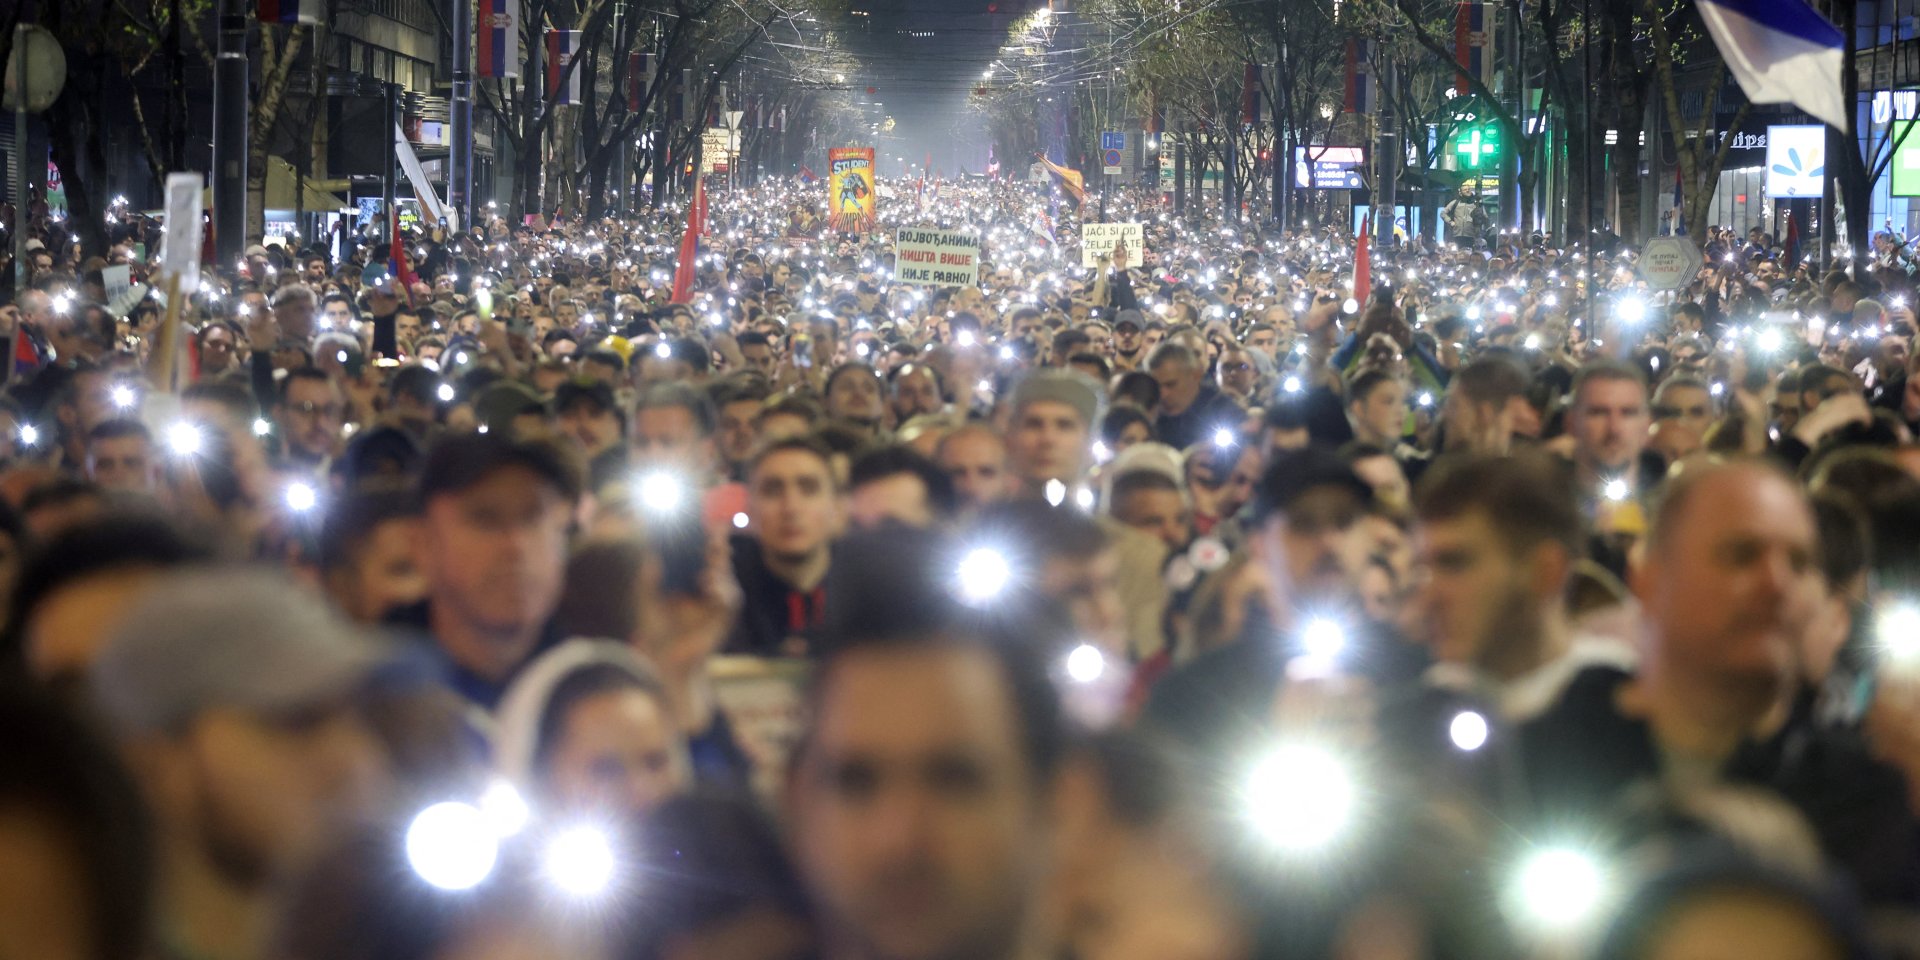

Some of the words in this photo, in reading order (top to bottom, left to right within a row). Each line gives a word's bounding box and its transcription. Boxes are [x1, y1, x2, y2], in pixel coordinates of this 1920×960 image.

[833, 160, 870, 174] STUDENT
[1110, 227, 1119, 236] SI
[1122, 226, 1137, 236] OD
[899, 231, 978, 248] ВОЈВОЂАНИМА
[900, 249, 936, 263] НИШТА
[940, 253, 972, 266] ВИШЕ
[902, 268, 930, 280] НИЈЕ
